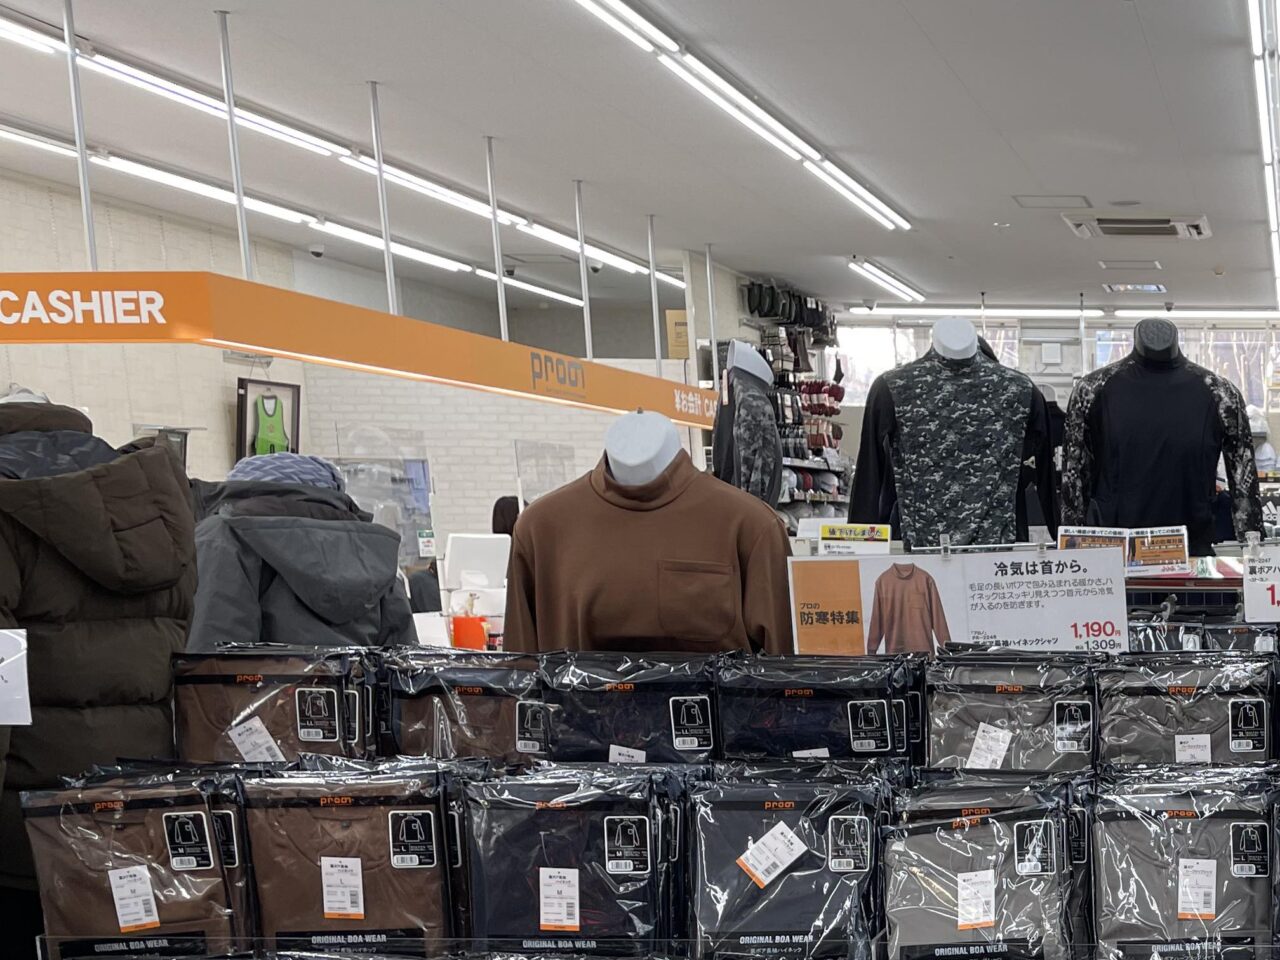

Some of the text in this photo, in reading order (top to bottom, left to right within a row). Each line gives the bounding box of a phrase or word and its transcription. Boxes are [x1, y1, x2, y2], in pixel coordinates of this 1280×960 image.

[0, 289, 167, 324] CASHIER
[994, 558, 1089, 577] 冷気は首から。
[800, 602, 821, 610] プロの
[799, 610, 861, 626] 防寒特集
[522, 940, 597, 948] ORIGINAL BOA WEAR
[739, 934, 813, 944] ORIGINAL BOA WEAR
[934, 944, 1008, 956] ORIGINAL BOA WEAR
